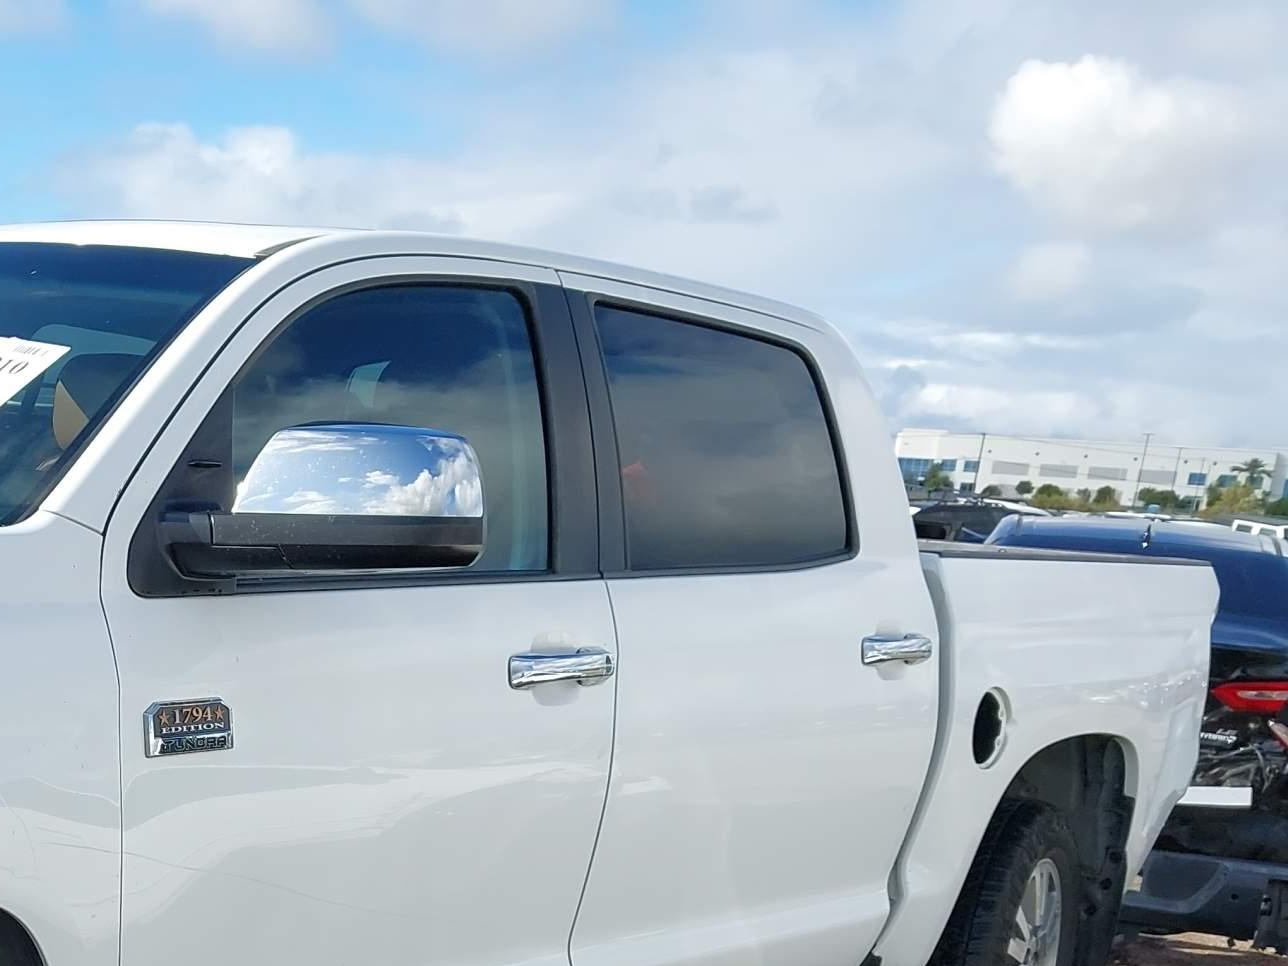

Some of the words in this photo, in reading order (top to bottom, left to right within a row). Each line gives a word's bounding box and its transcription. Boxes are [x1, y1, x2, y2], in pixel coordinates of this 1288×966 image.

[172, 705, 213, 724] 1794
[161, 721, 225, 734] EDITION
[161, 736, 228, 753] TUNDRA
